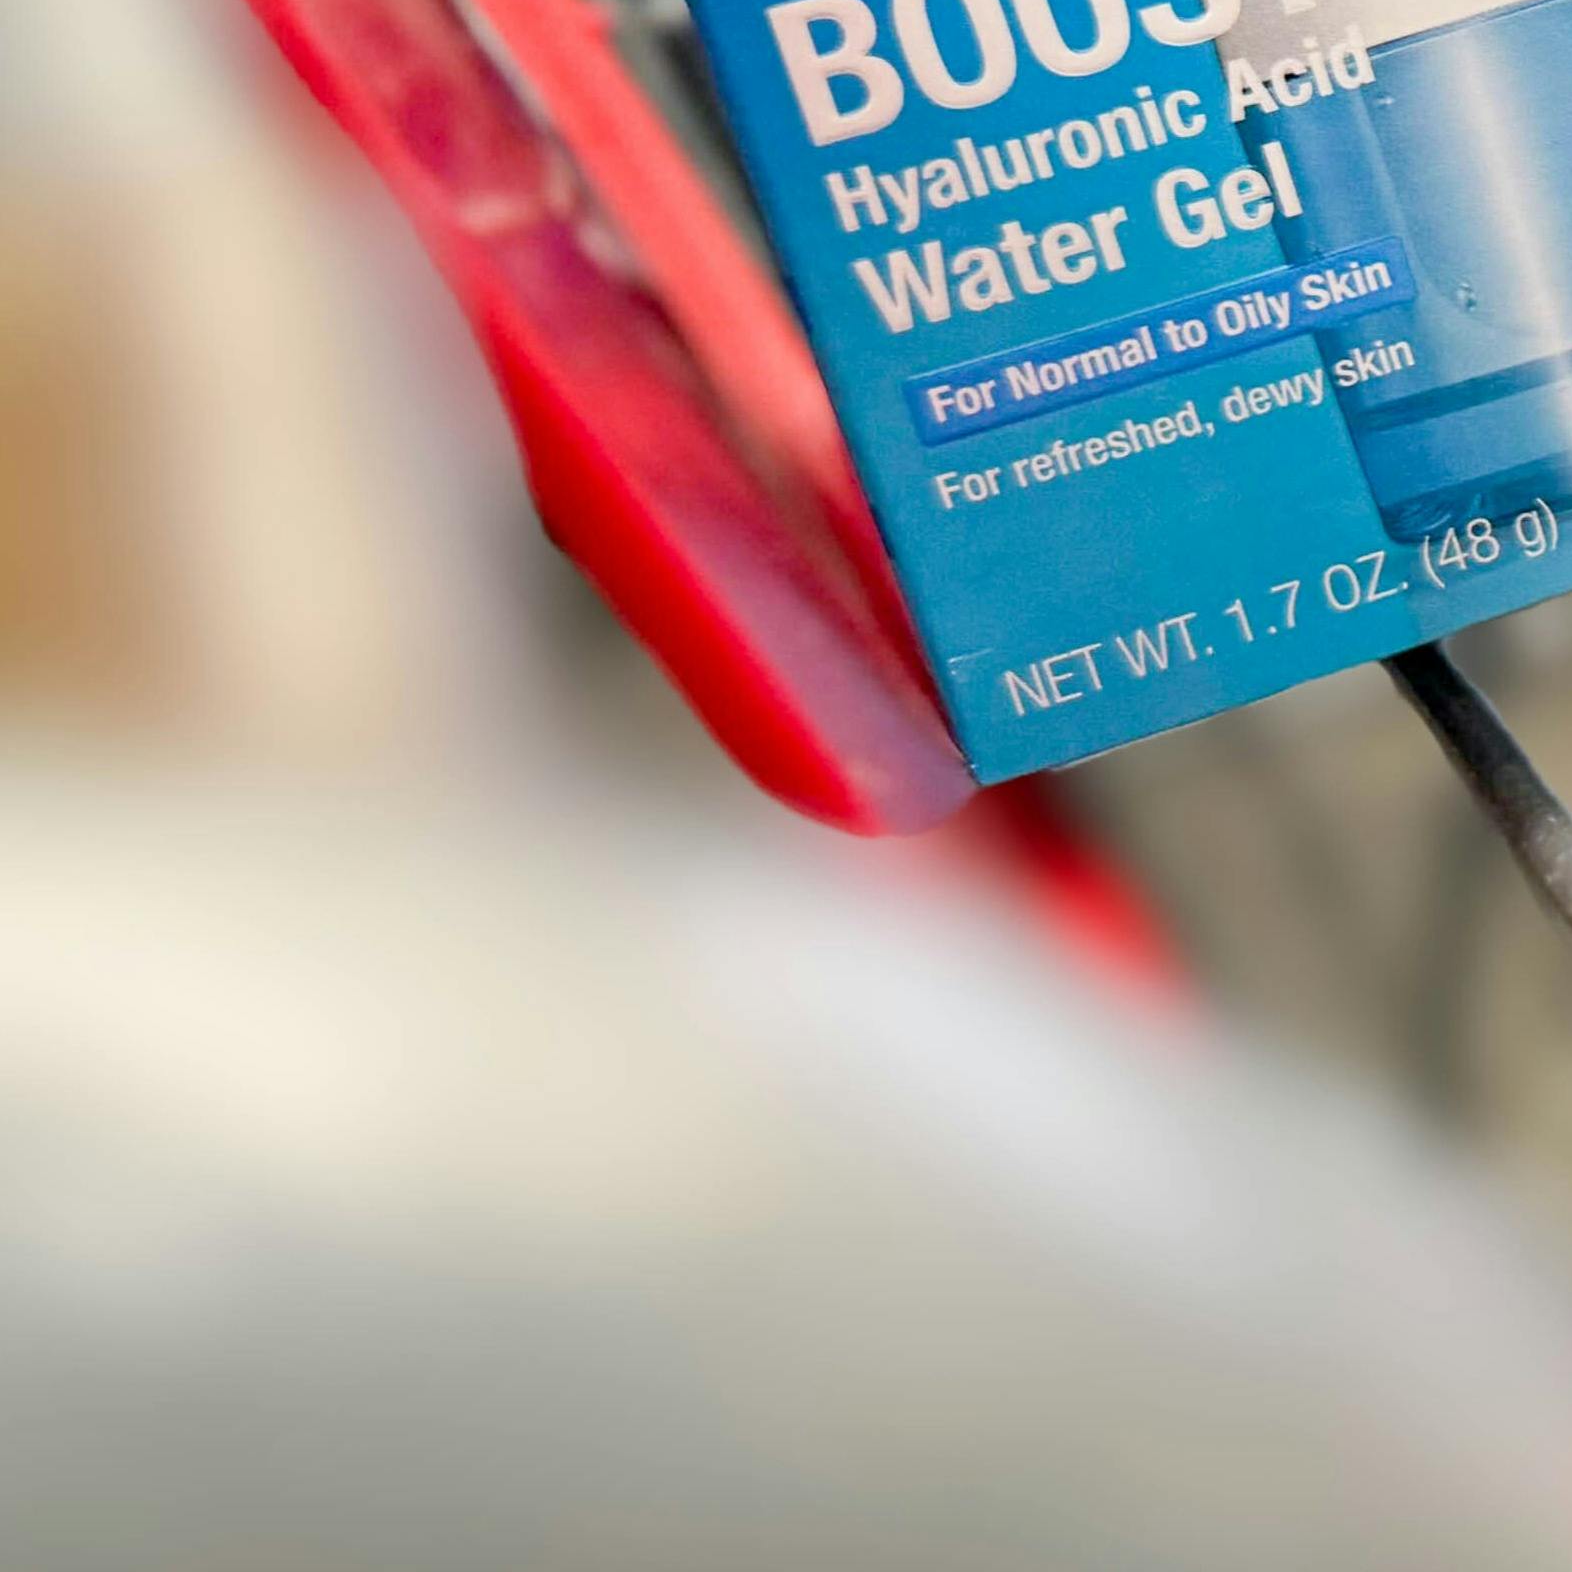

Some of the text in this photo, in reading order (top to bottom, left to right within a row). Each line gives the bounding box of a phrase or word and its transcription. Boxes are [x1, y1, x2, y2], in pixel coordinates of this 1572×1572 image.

[825, 24, 1377, 233] Hyaluronic Acid
[853, 141, 1304, 333] Water Gel
[926, 260, 1393, 424] For Normal to Oily Skin
[934, 337, 1416, 510] For refreshed, dewy skin
[1003, 498, 1560, 718] NET WT. 1.7 OZ. (48 g)
